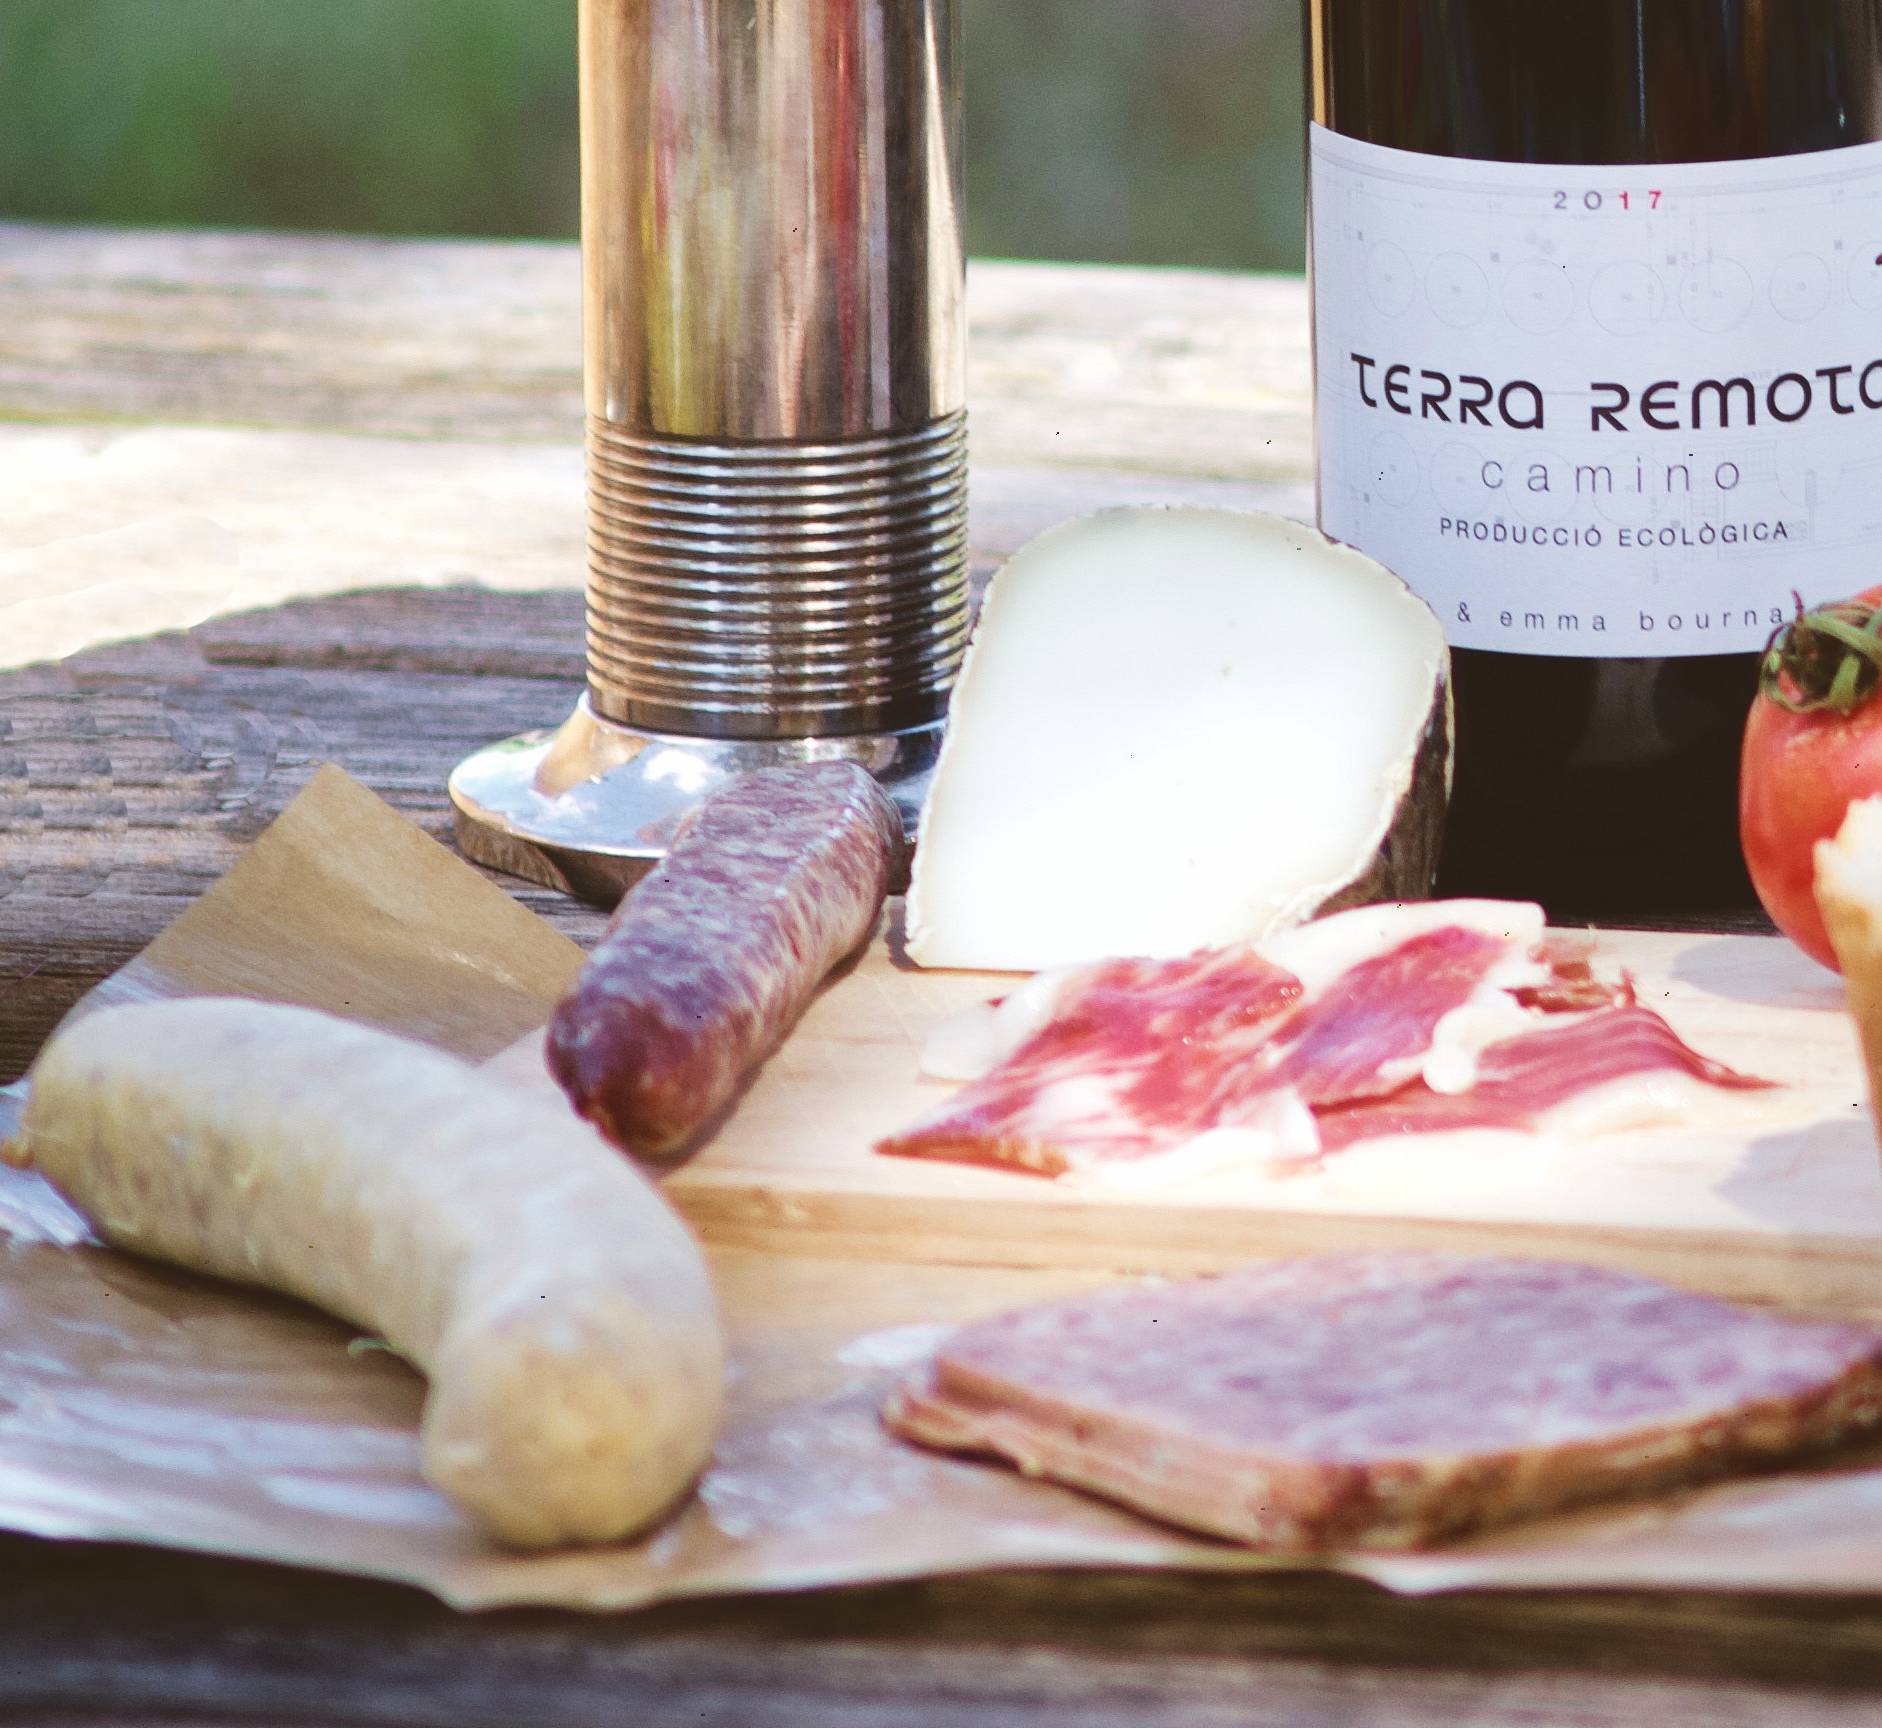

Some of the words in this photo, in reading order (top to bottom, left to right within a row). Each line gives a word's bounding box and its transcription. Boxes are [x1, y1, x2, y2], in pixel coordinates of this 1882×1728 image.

[1553, 189, 1663, 211] 2017
[1349, 351, 1545, 431] TERRA
[1481, 456, 1740, 494] camino
[1440, 516, 1602, 548] PRODUCCIÓ
[1618, 519, 1789, 548] ECOLÒGICA
[1457, 600, 1473, 624] &
[1499, 610, 1607, 633] emma
[1639, 606, 1804, 633] bourna
